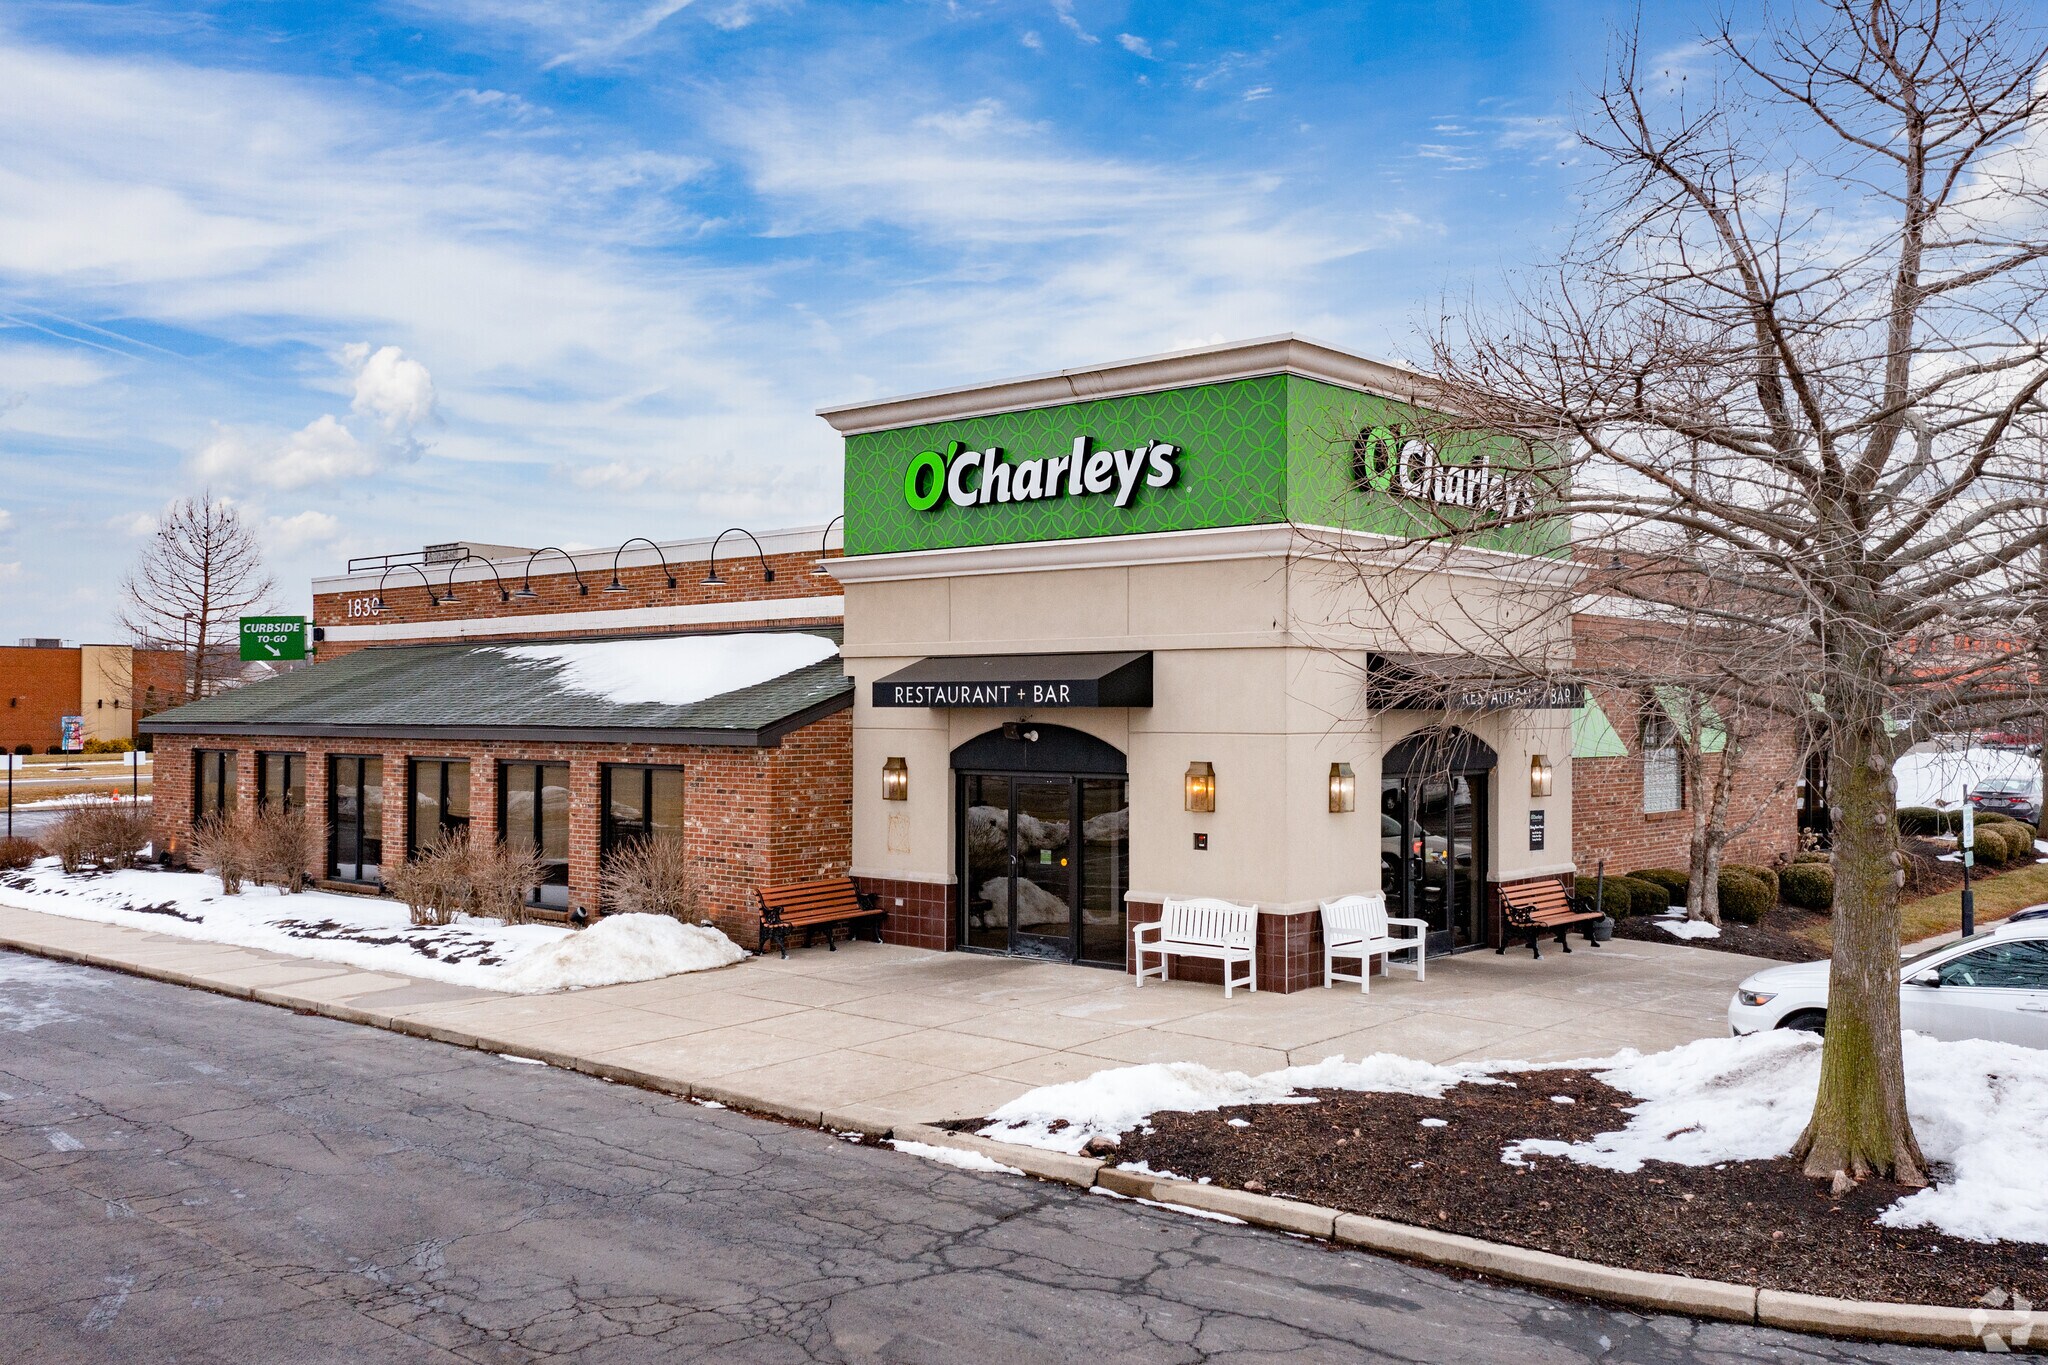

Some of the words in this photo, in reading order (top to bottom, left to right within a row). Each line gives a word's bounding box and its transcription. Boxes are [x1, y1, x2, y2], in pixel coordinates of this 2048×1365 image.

[904, 436, 1175, 511] O'Charley's
[243, 622, 301, 633] CURBSIDE
[257, 635, 288, 643] TO-GO
[895, 686, 1011, 704] RESTAURANT
[1033, 685, 1071, 703] BAR
[1462, 687, 1541, 705] RESAURAN
[1551, 687, 1571, 705] BAR
